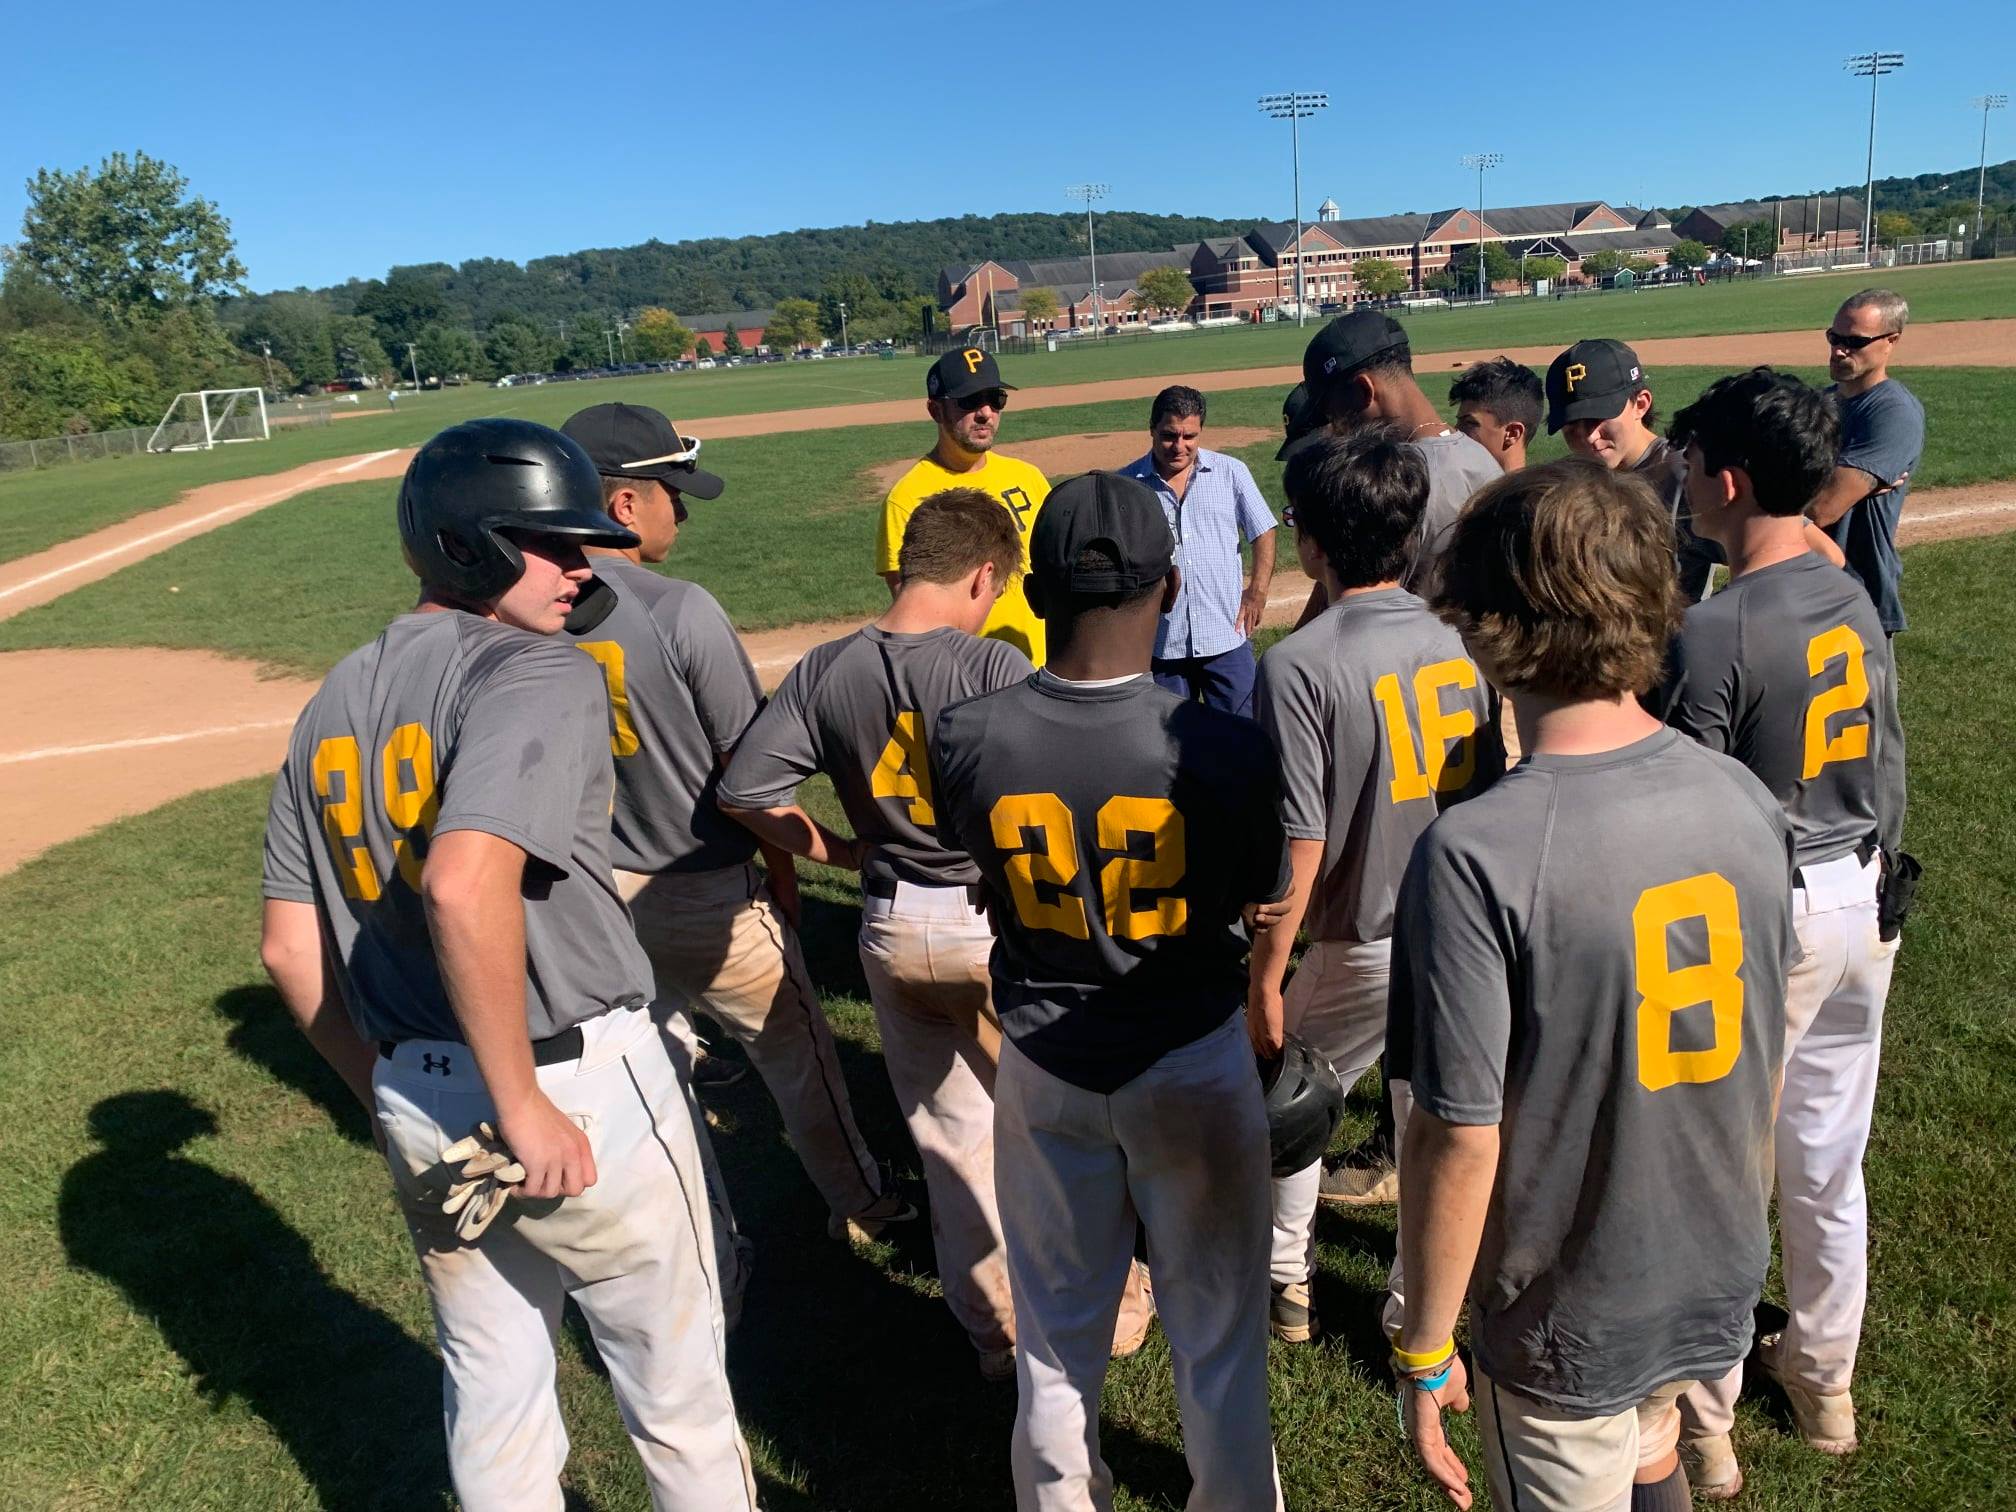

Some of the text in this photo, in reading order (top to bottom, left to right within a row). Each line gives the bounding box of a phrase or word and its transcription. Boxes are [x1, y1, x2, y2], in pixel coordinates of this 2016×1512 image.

[962, 347, 984, 374] P
[1565, 363, 1587, 393] P
[1000, 486, 1033, 533] P
[870, 710, 936, 826] 4
[1374, 657, 1477, 804] 16
[1801, 624, 1869, 781] 2
[313, 720, 441, 902] 29
[990, 792, 1187, 941] 22
[1632, 872, 1745, 1091] 8
